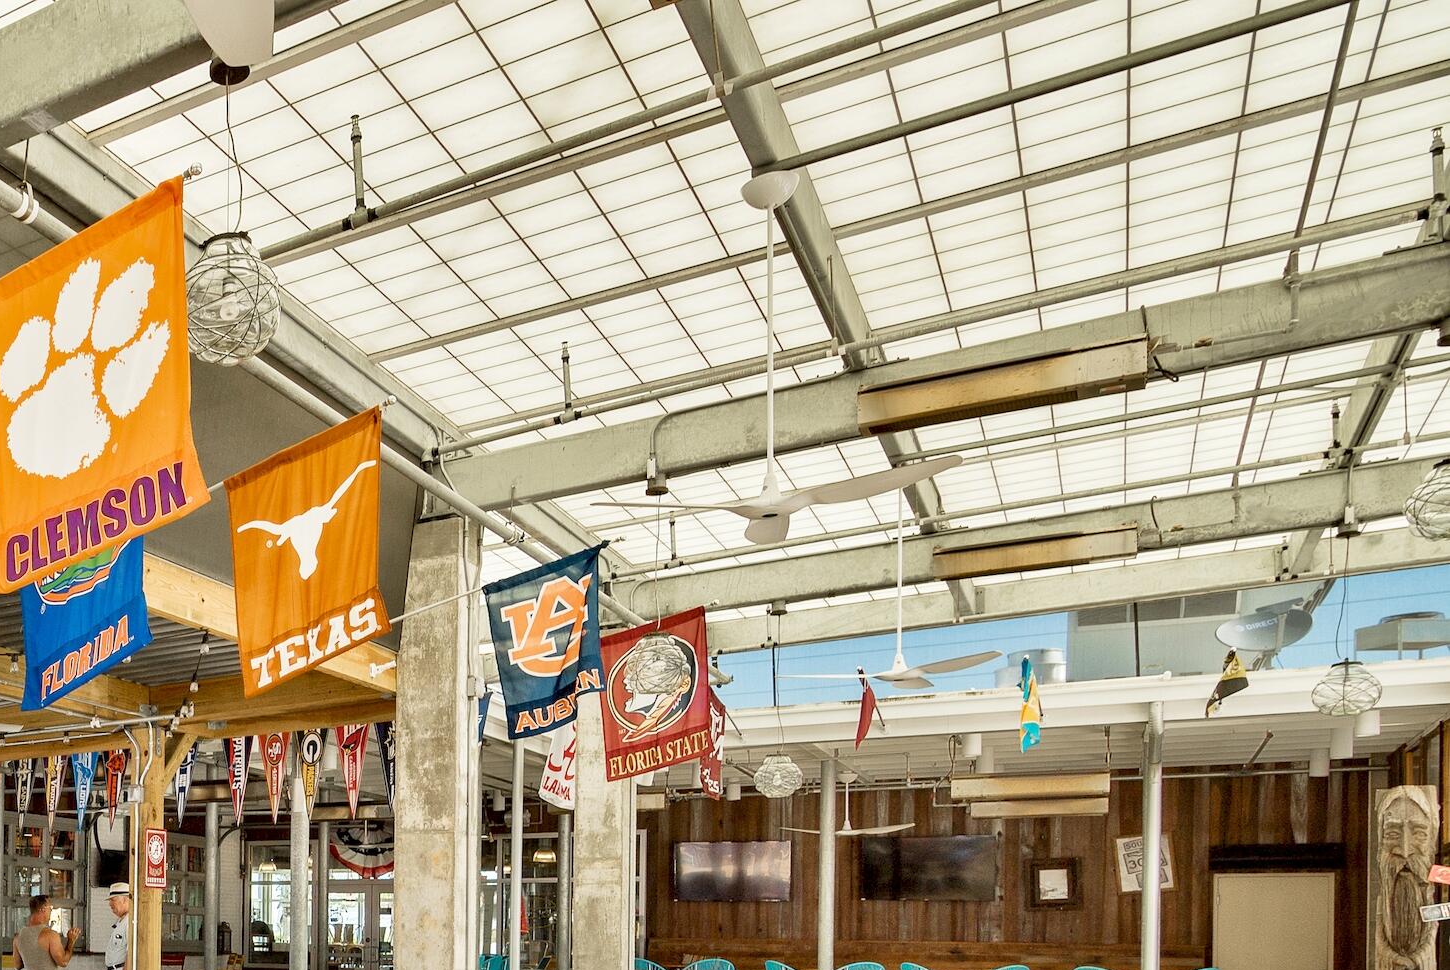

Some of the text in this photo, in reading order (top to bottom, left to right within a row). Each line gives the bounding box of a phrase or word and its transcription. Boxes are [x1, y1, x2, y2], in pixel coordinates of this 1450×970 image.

[6, 461, 188, 583] CLEMSON
[251, 598, 378, 689] TEXAS
[1245, 617, 1279, 630] DIRECT
[41, 614, 130, 700] FLORIDA
[232, 736, 243, 790] PATRIOTS
[666, 729, 709, 762] STATE
[19, 785, 27, 811] SAINTS
